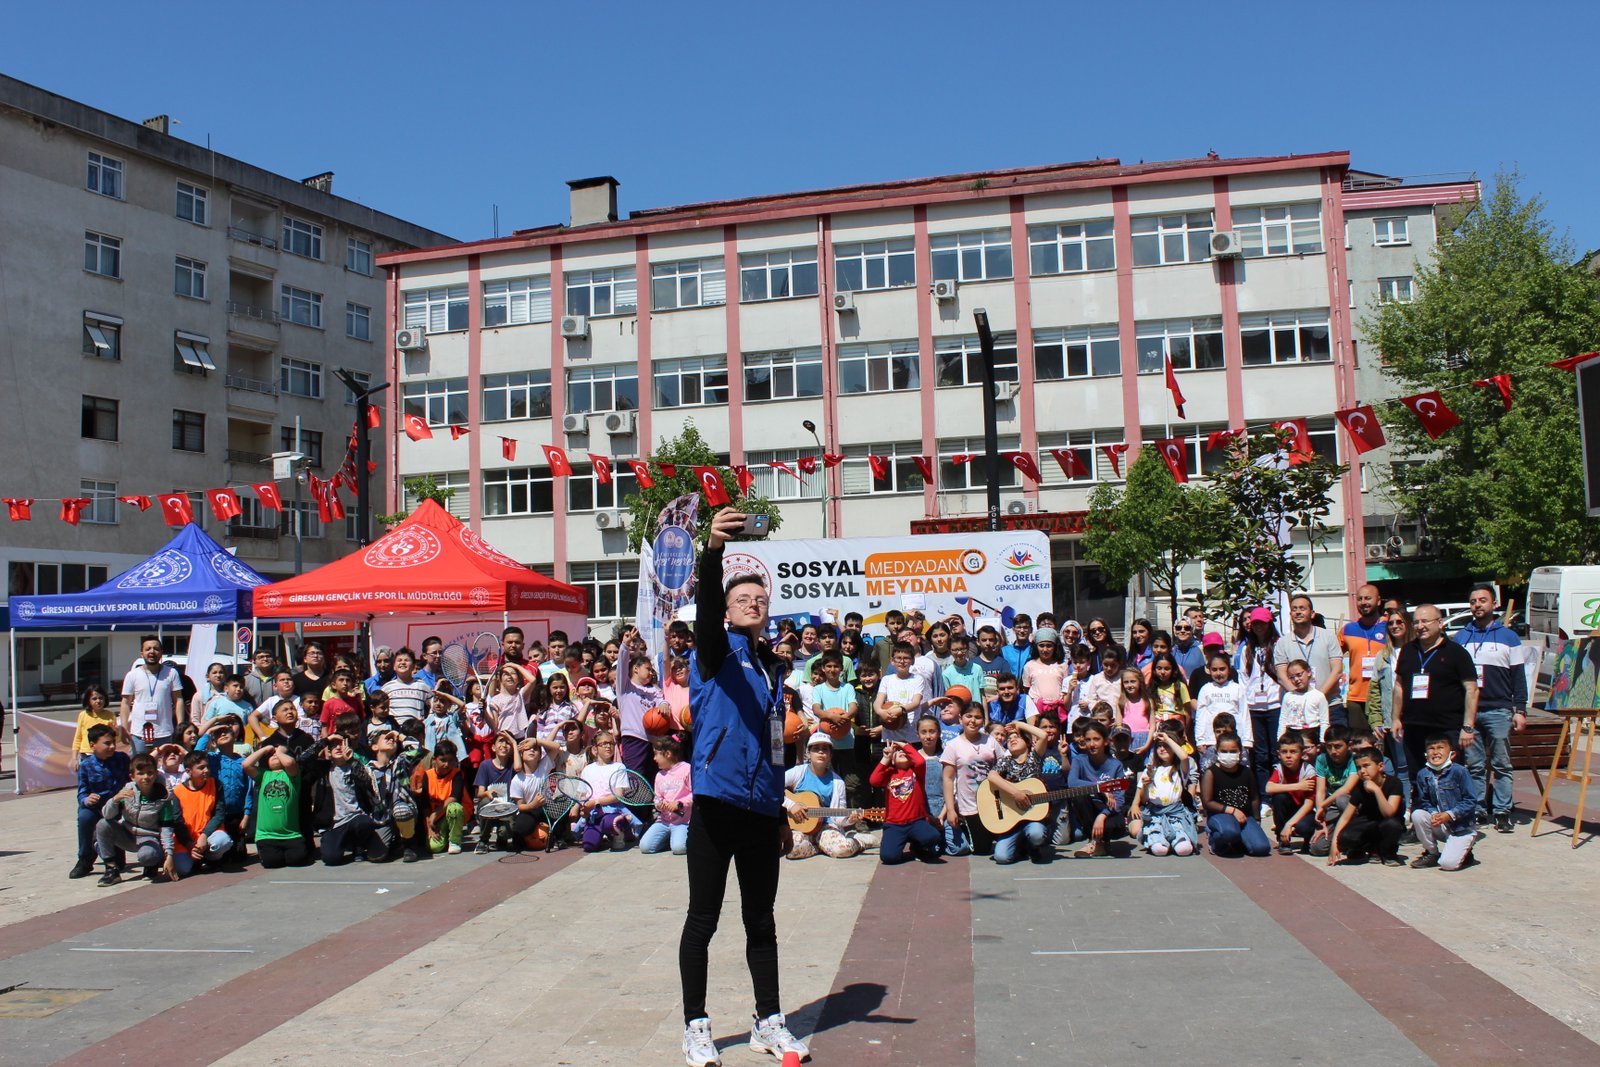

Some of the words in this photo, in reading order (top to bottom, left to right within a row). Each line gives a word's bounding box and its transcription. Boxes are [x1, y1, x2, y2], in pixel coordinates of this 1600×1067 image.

[777, 560, 865, 579] SOSYAL
[869, 558, 960, 575] MEDYADAN
[1003, 573, 1040, 582] GÖRELE
[780, 581, 860, 599] SOSYAL
[866, 576, 968, 596] MEYDANA
[288, 593, 325, 603] GİRESUN
[325, 592, 361, 603] GENÇLİK
[362, 591, 373, 600] VE
[374, 591, 397, 600] SPOR
[397, 590, 406, 600] İL
[407, 591, 462, 601] MÜDÜRLÜĞÜ
[41, 605, 73, 614] GİRESUN
[74, 603, 105, 614] GENÇLİK
[107, 604, 116, 612] VE
[117, 603, 138, 611] SPOR
[139, 601, 146, 611] İL
[147, 600, 198, 611] MÜDÜRLÜĞÜ
